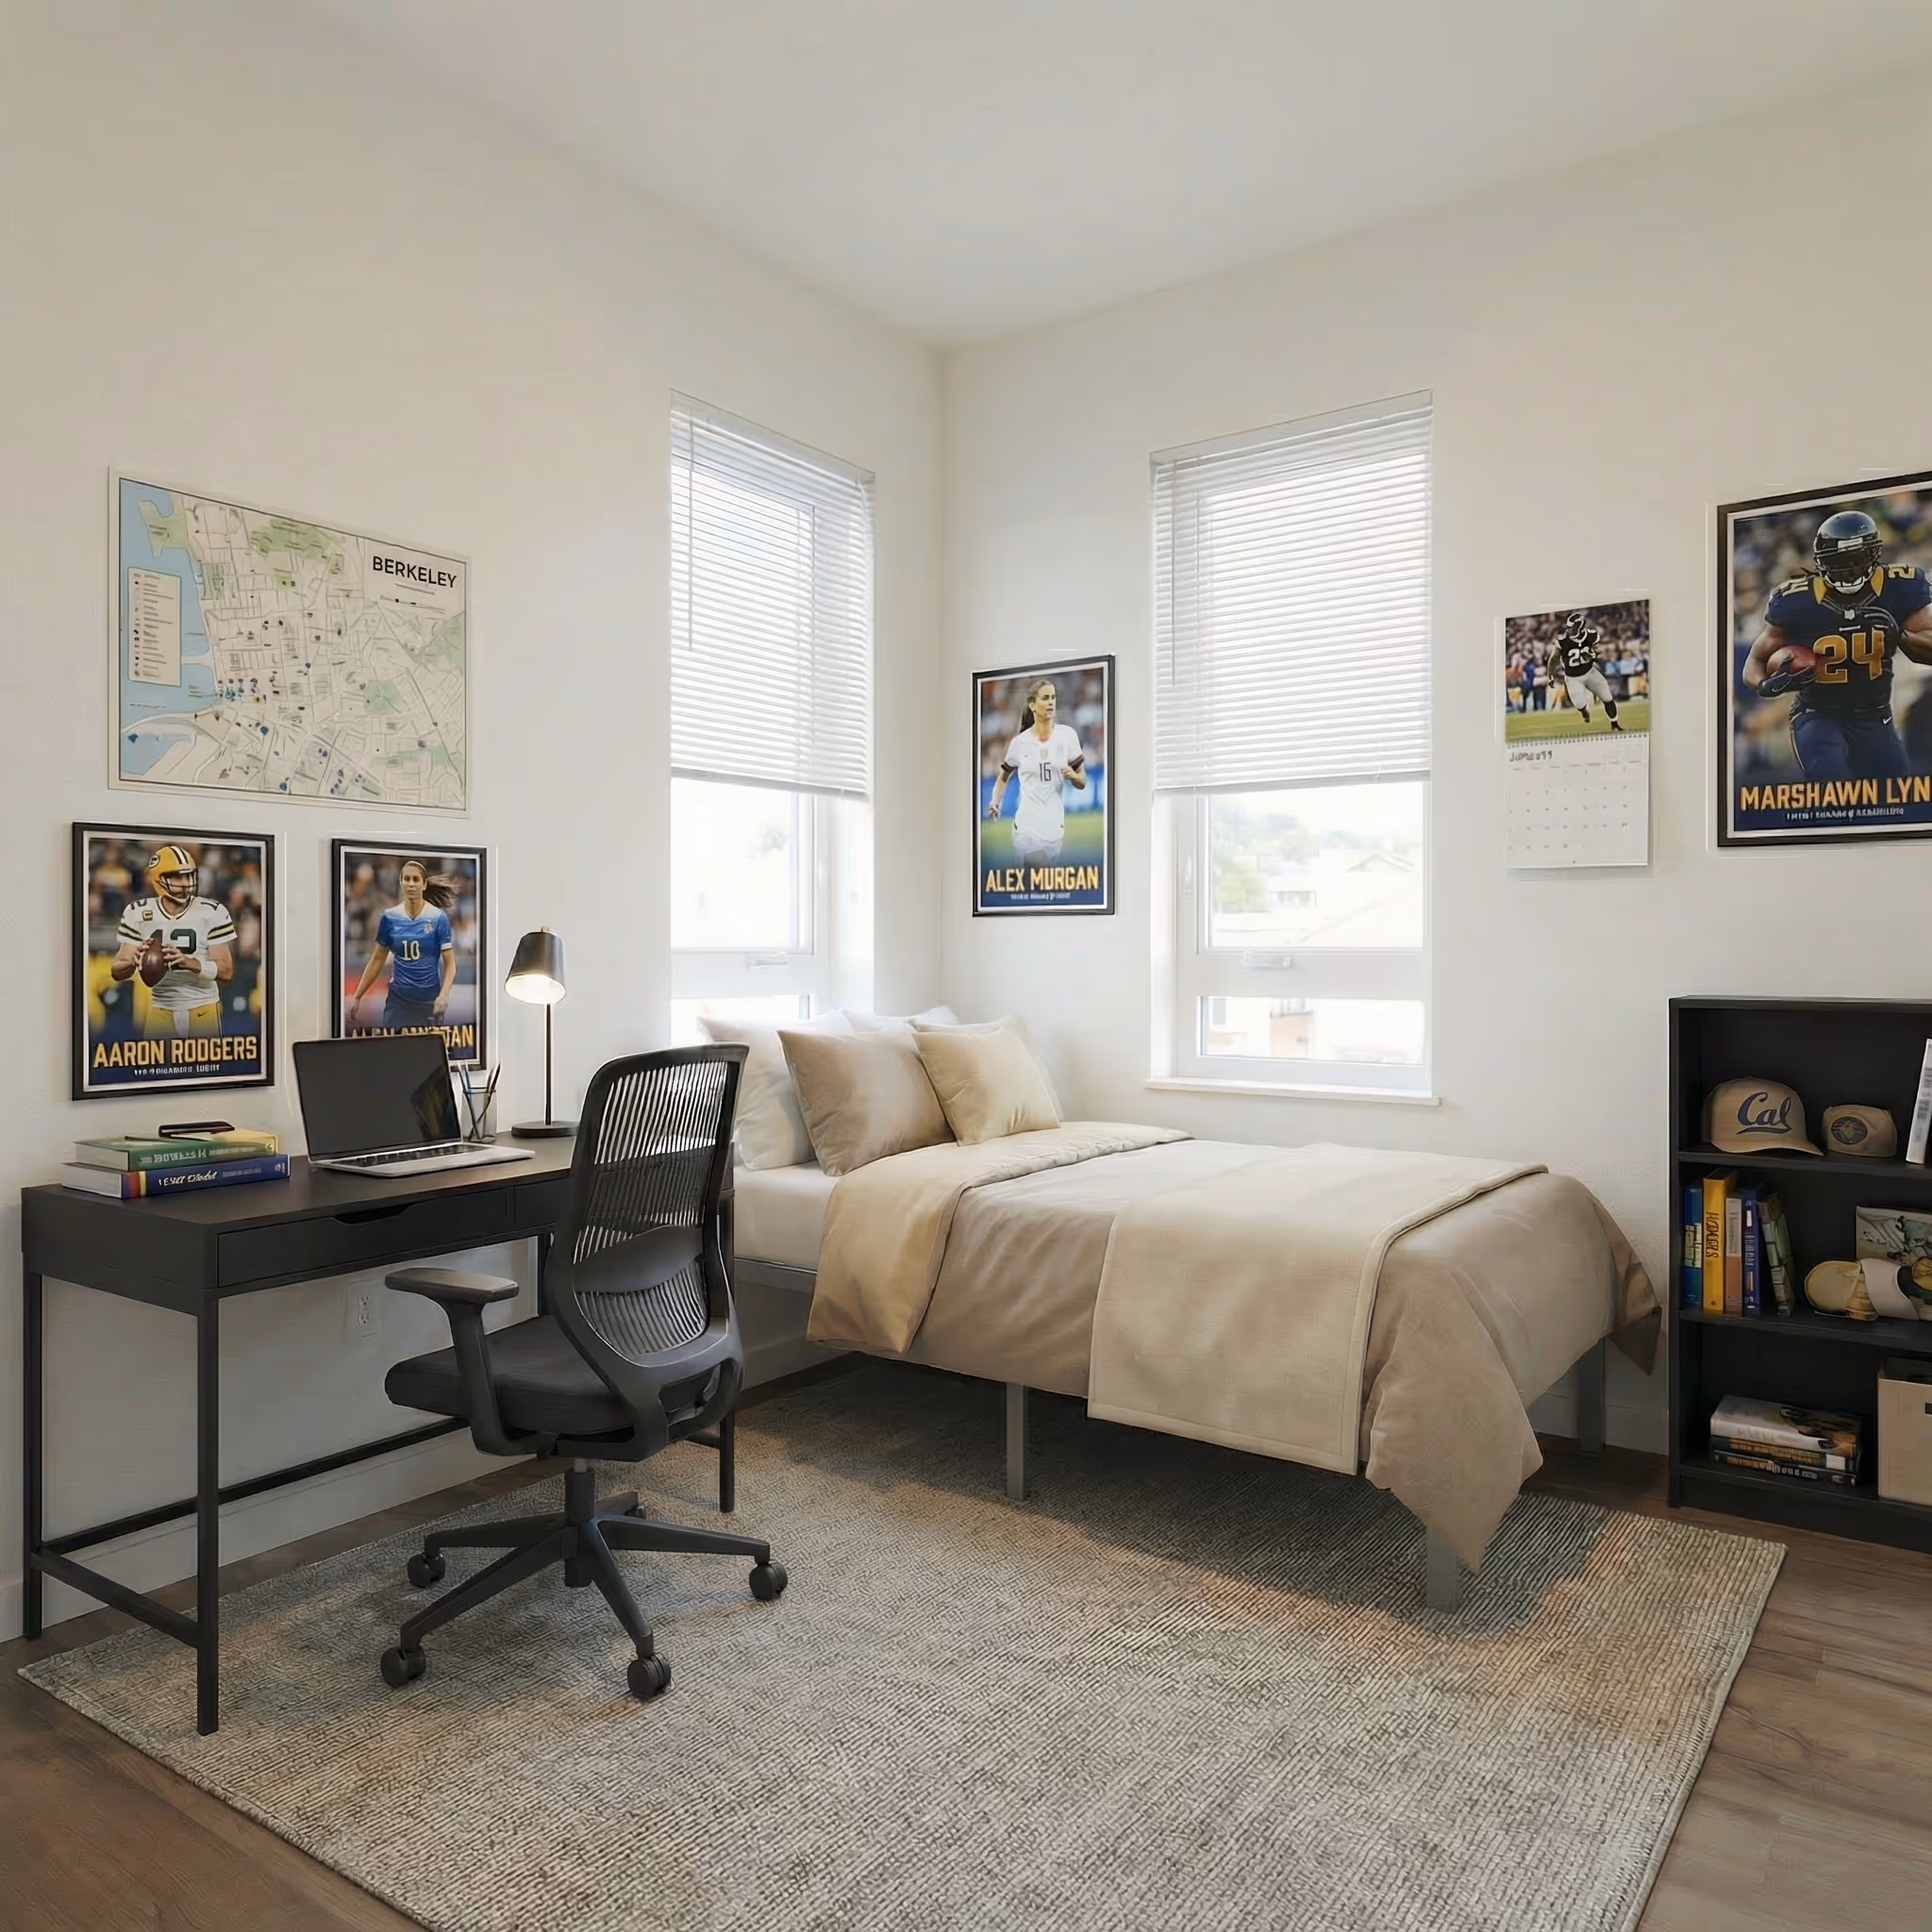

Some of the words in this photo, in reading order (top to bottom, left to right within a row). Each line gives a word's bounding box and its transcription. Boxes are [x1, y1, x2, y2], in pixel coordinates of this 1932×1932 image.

[373, 556, 457, 588] BERKELEY
[1813, 626, 1885, 684] 24
[1039, 762, 1052, 782] 16
[1740, 778, 1878, 811] MARSHAWN
[1887, 775, 1931, 804] LYN
[985, 868, 1025, 892] ALEX
[401, 940, 421, 961] 10
[92, 1040, 164, 1068] AARON
[171, 1036, 258, 1064] RODGERS
[1736, 1091, 1792, 1135] Cal
